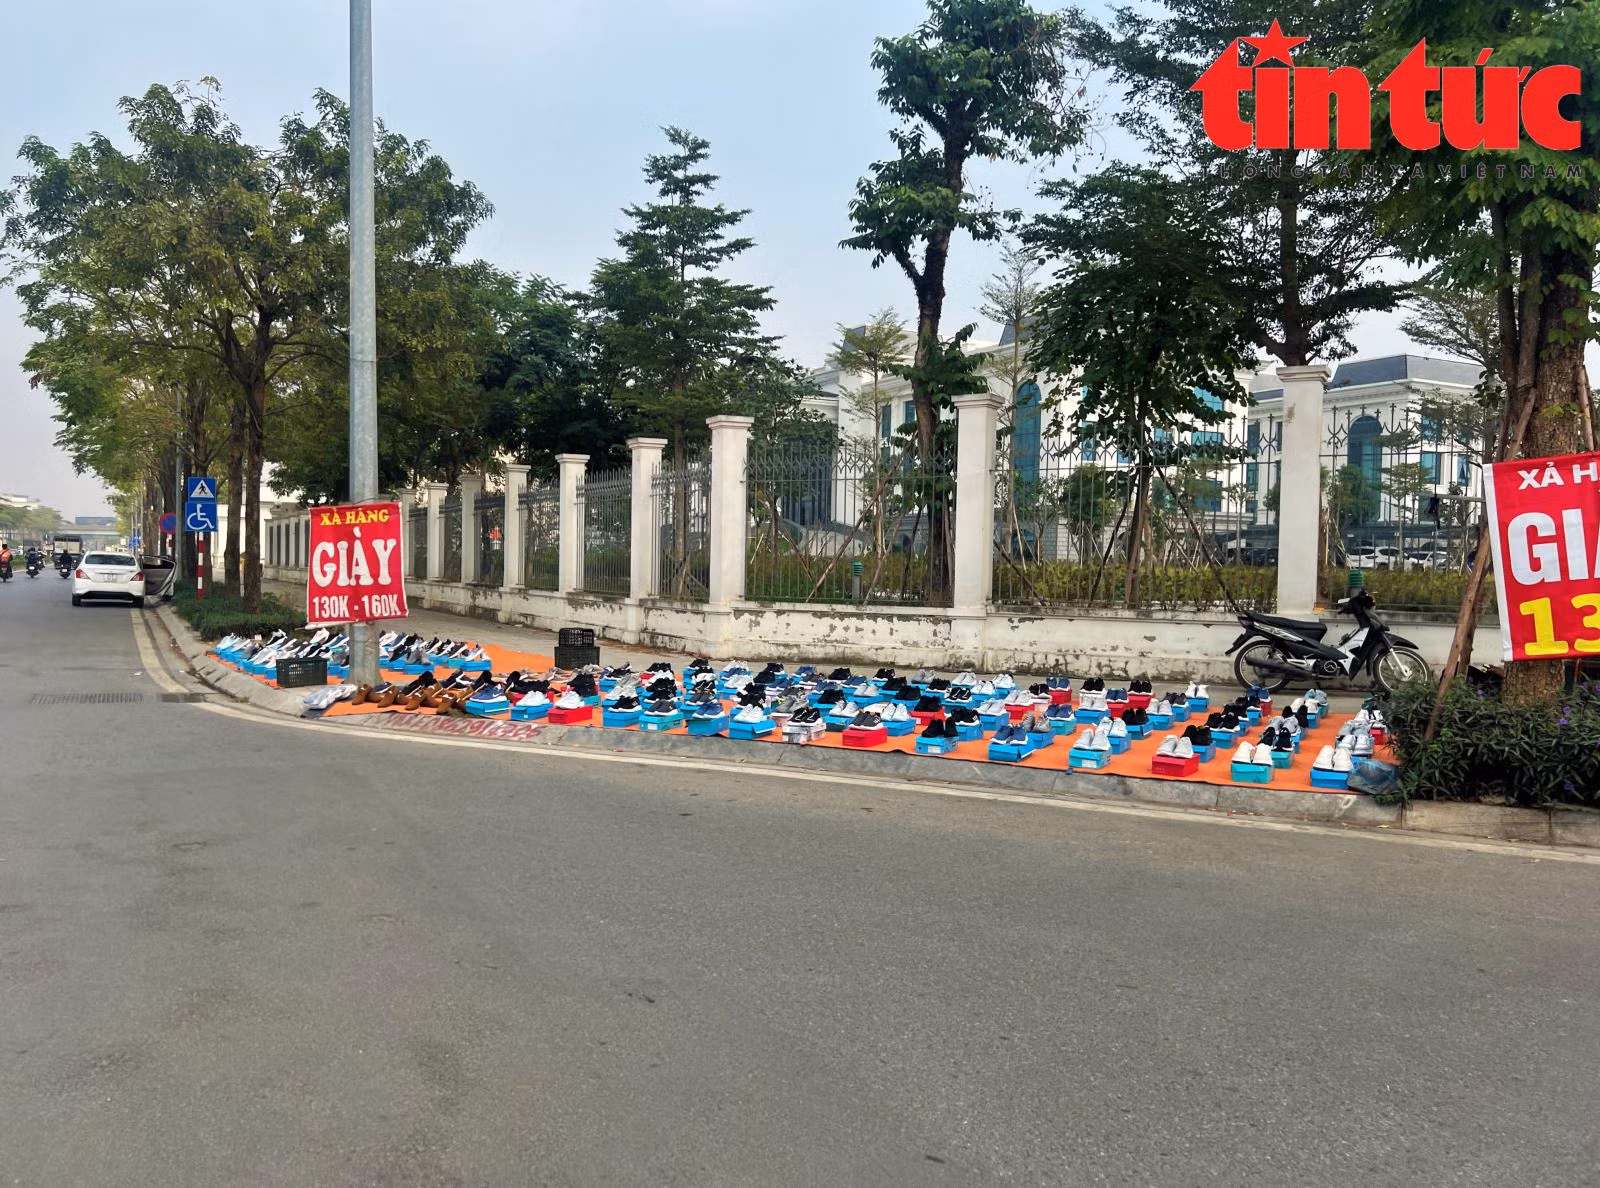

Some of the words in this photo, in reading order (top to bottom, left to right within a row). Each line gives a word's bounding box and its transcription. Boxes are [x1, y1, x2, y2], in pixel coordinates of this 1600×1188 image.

[1517, 462, 1564, 490] XẢ
[1572, 461, 1600, 484] H
[312, 526, 397, 587] GIÀY
[1507, 508, 1600, 586] GI
[312, 595, 350, 618] 130K
[361, 594, 402, 617] 160K
